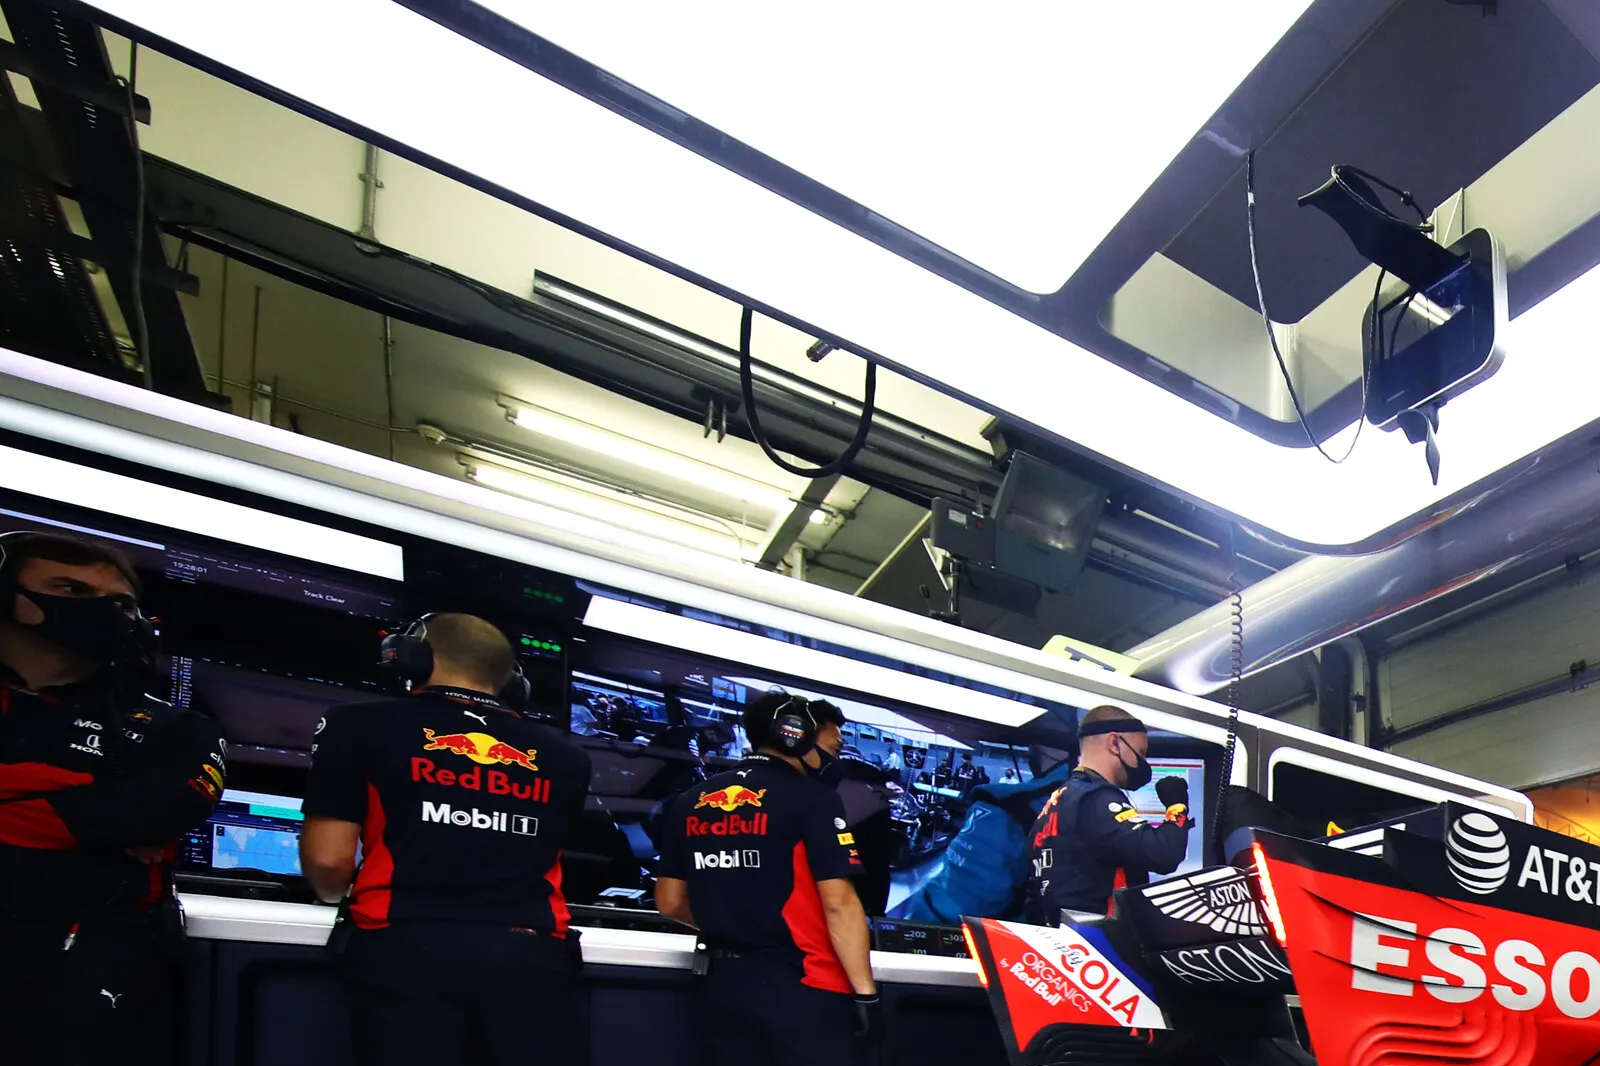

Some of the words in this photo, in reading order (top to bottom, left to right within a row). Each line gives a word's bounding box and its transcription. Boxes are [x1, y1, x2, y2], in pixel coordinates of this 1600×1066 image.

[303, 589, 325, 601] Track
[325, 594, 346, 605] Clear
[422, 801, 507, 833] Mobil
[1209, 880, 1252, 908] ASTON
[1000, 957, 1010, 968] by
[1160, 939, 1293, 985] ASTON
[1022, 951, 1093, 1013] ORGANICS
[1061, 943, 1140, 1025] COLA
